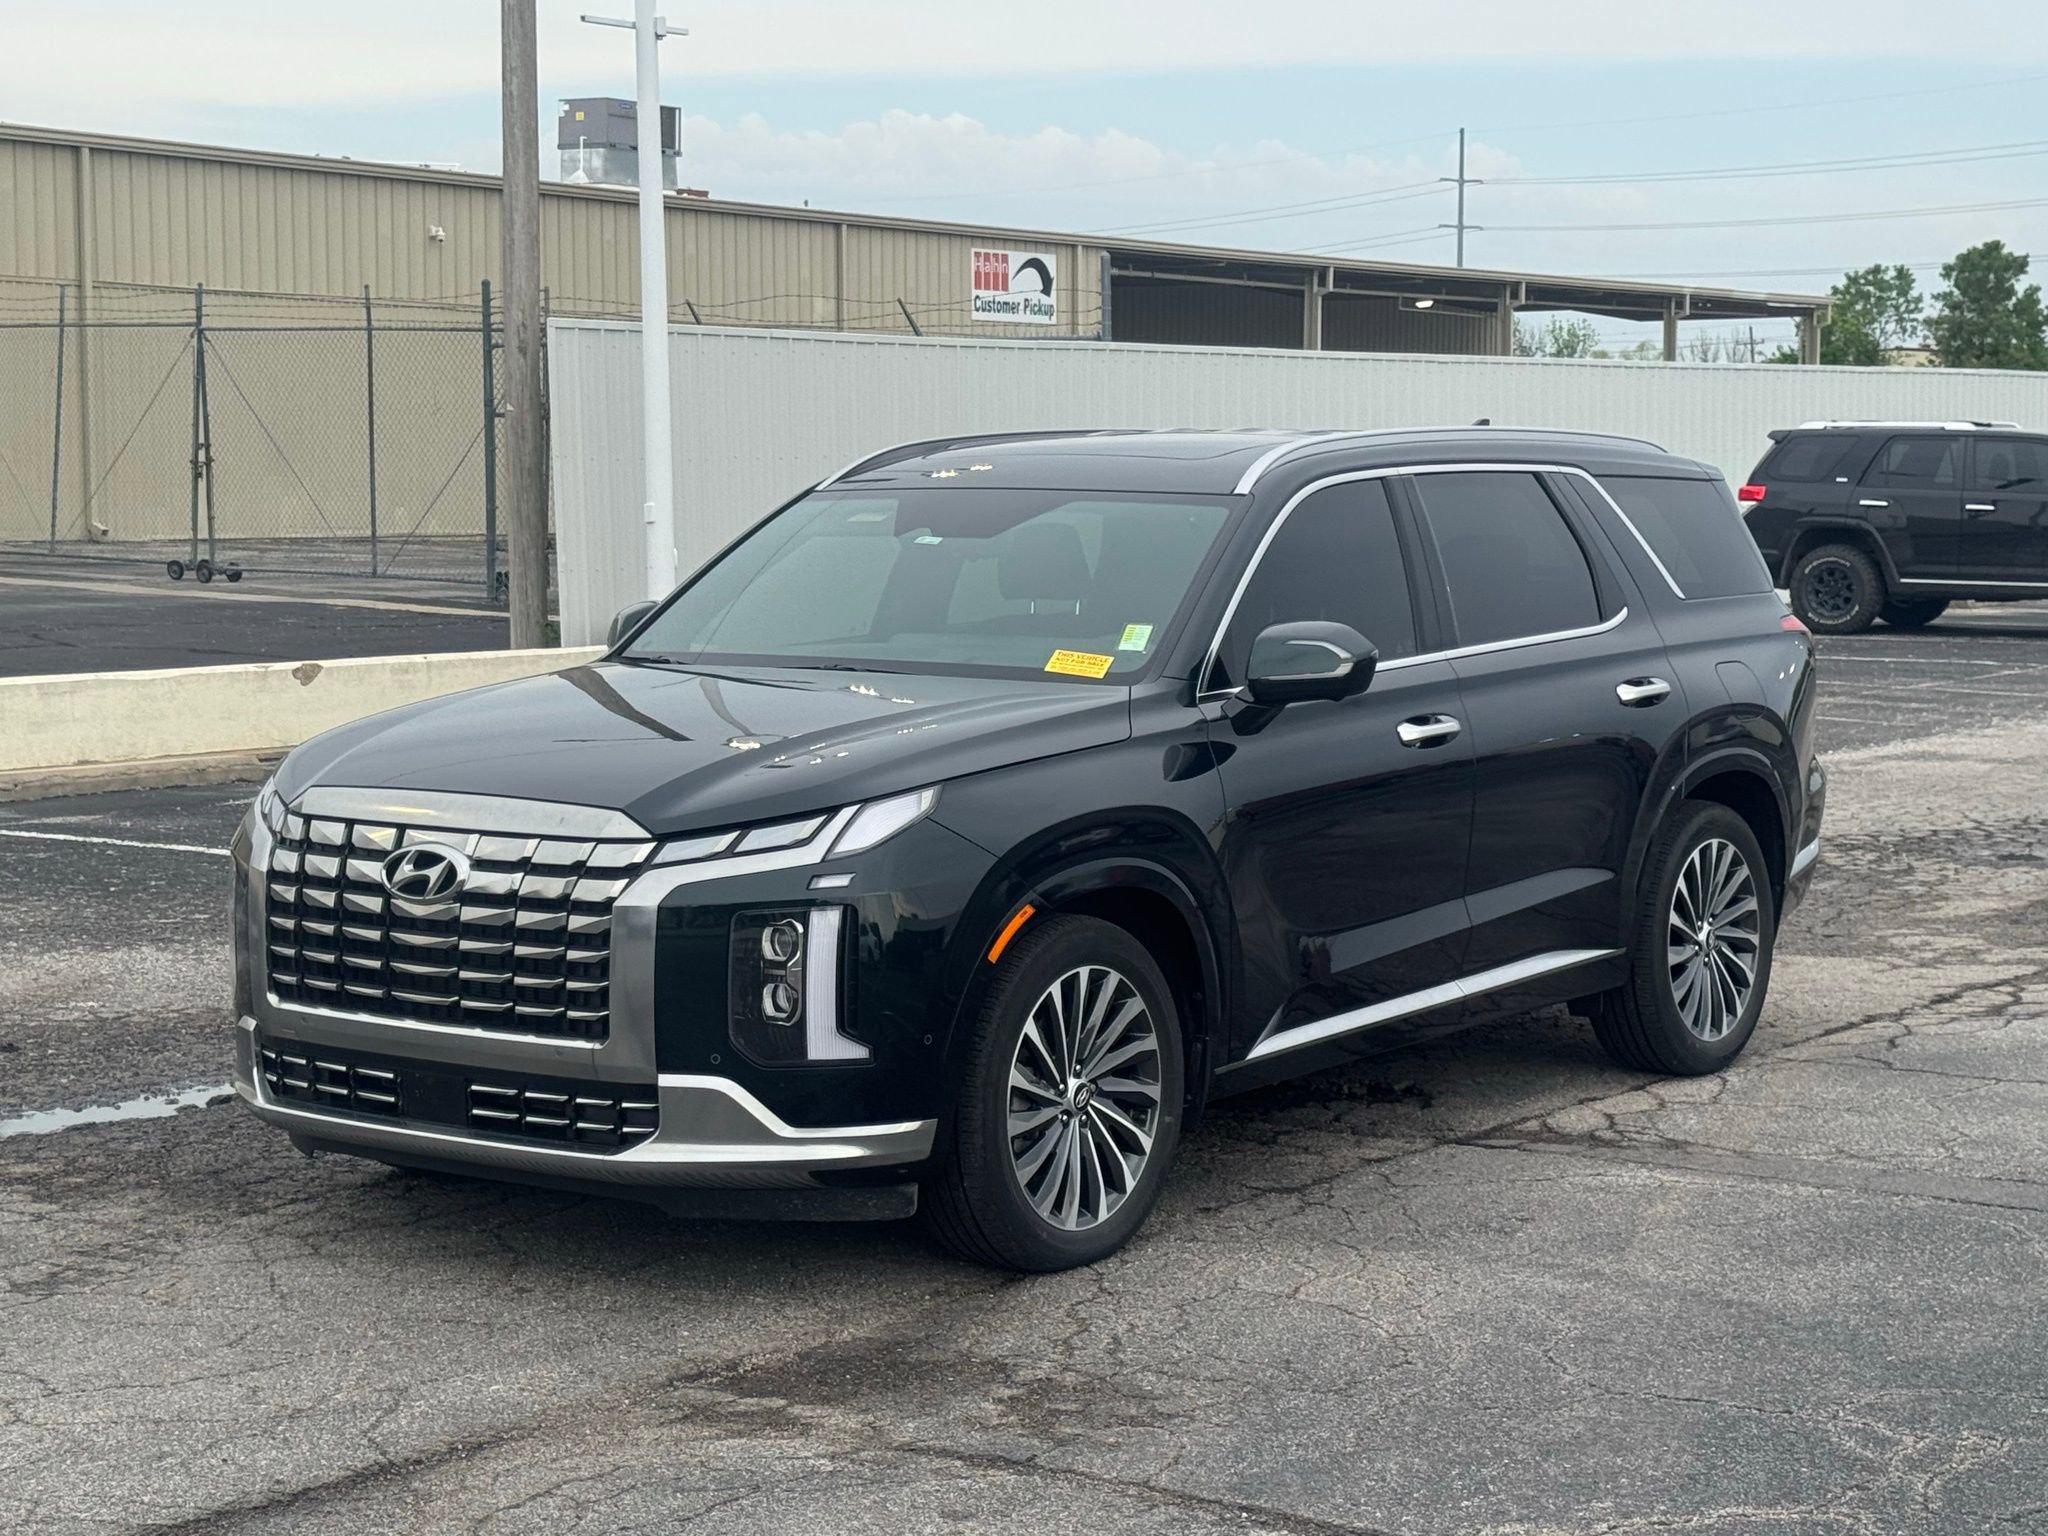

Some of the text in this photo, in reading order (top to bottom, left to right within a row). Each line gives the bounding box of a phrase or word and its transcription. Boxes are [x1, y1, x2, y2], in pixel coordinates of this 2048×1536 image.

[975, 256, 1008, 273] Hahn
[974, 295, 1055, 321] Customer Pickup
[1077, 654, 1110, 663] VEHICLE
